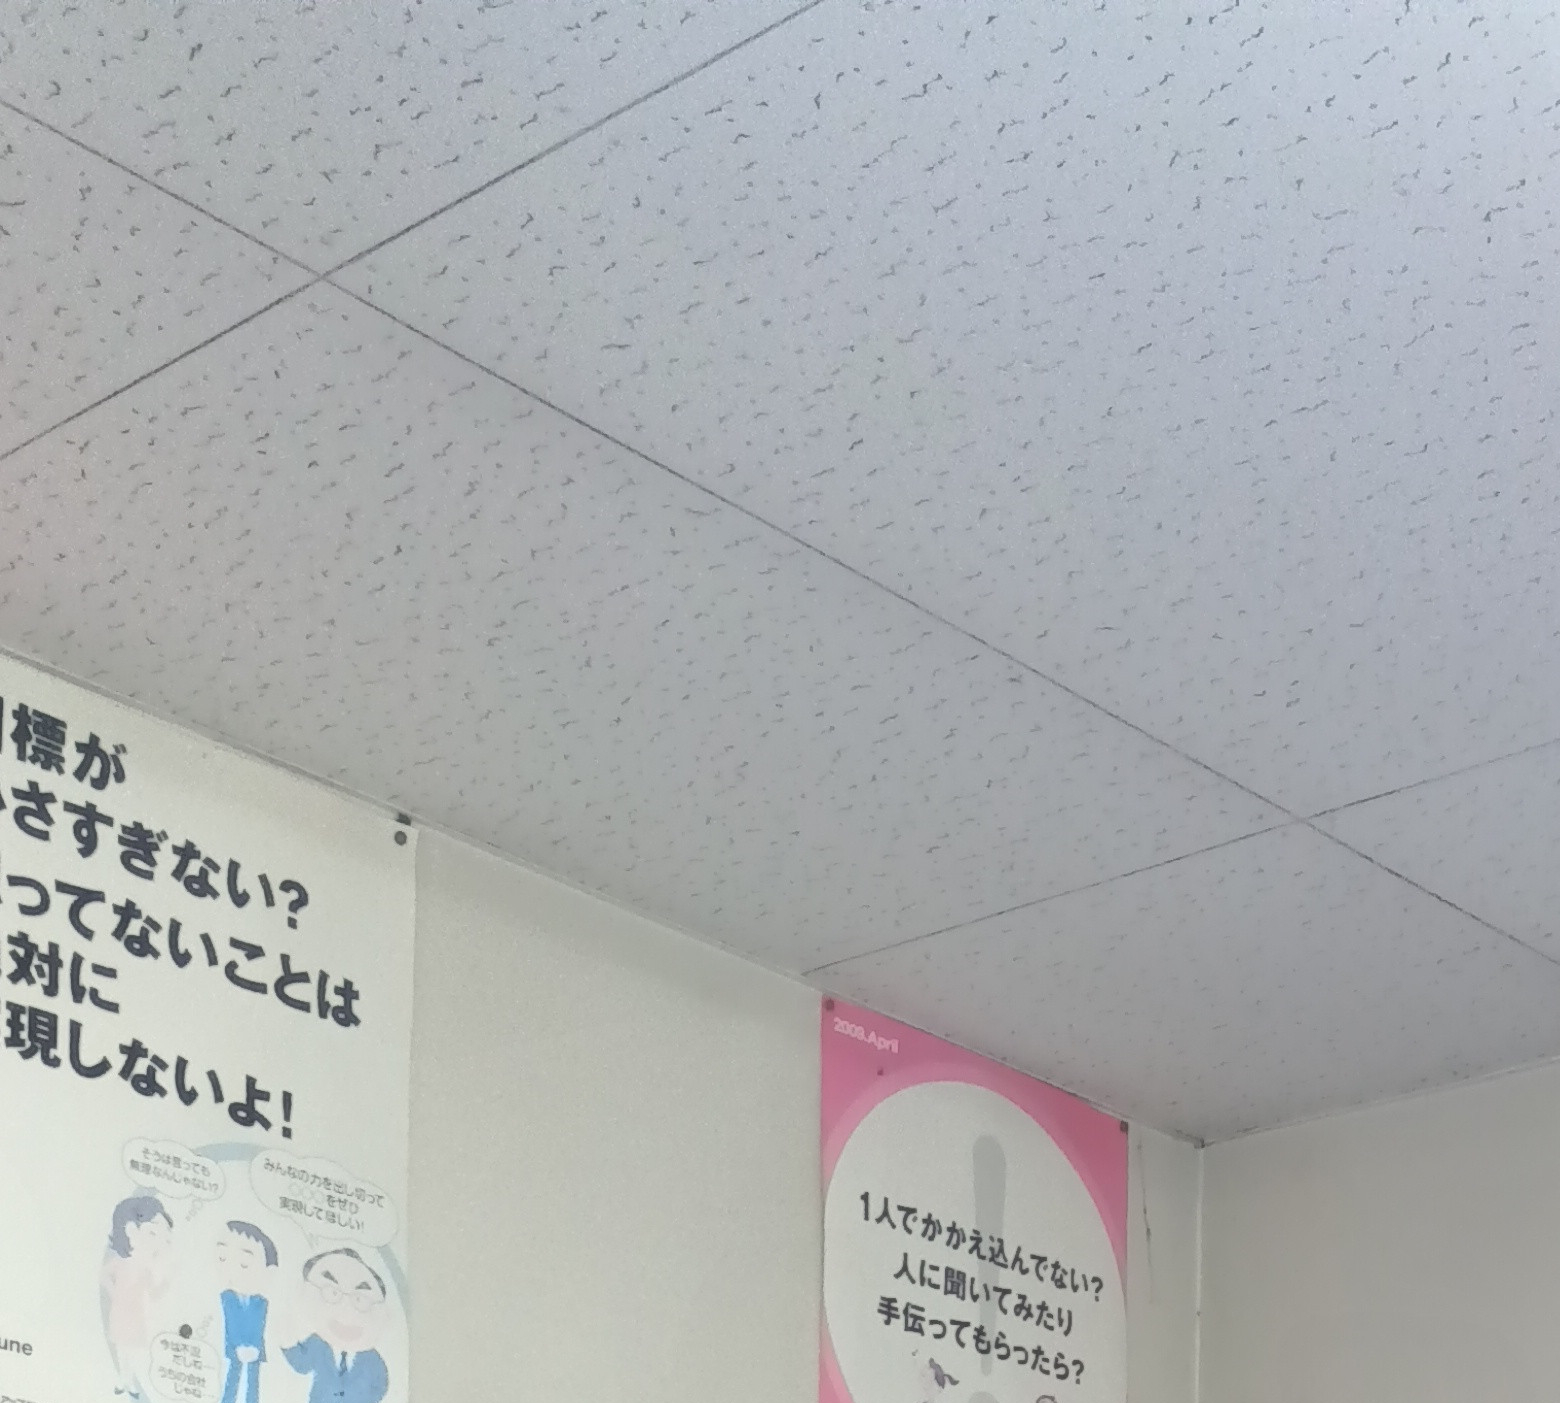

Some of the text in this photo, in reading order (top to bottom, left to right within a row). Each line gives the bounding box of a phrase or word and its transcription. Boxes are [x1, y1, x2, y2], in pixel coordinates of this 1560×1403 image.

[0, 697, 127, 791] 標が
[0, 779, 309, 930] さすぎない?
[0, 874, 362, 1028] ってないことは
[0, 930, 120, 1014] 対に
[860, 1190, 1104, 1303] 1人でかかえ込んでない?
[877, 1295, 1085, 1385] 手伝ってもらったら?
[893, 1252, 1073, 1337] 人に聞いてみたり
